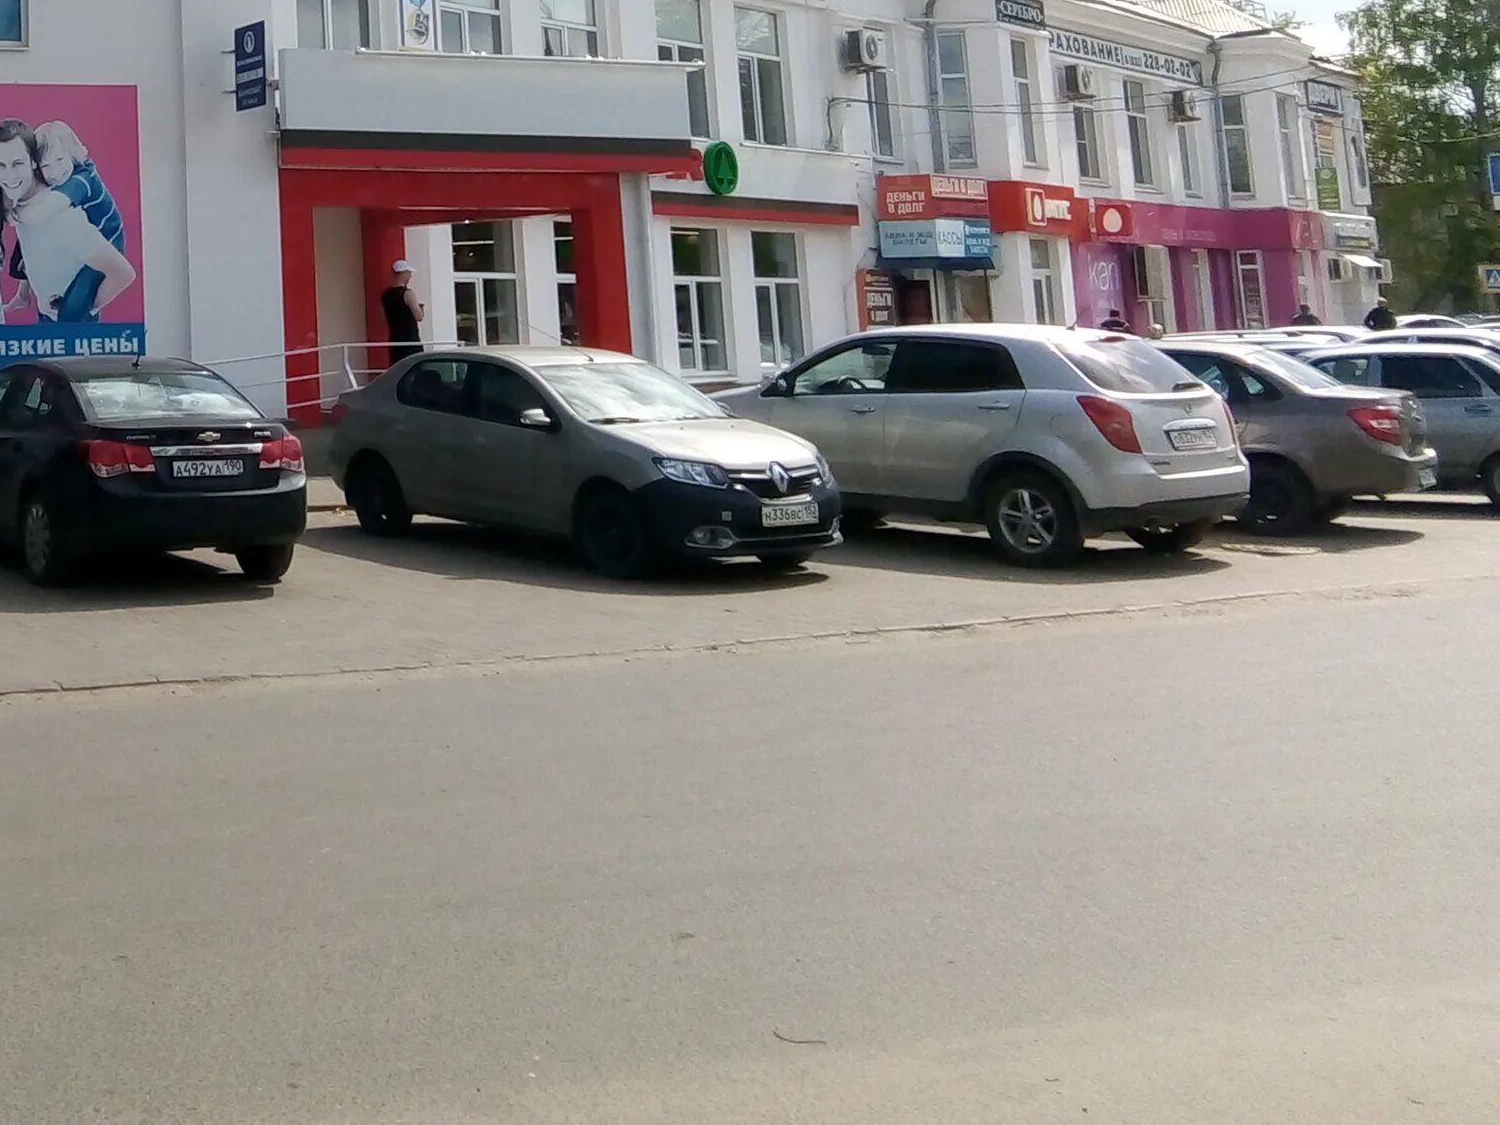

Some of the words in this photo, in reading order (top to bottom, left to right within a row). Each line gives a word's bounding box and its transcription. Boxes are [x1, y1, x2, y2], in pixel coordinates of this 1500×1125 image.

[1000, 0, 1042, 23] СЕРЕБРО
[886, 190, 926, 204] ДЕНЬГИ
[887, 203, 895, 214] В
[897, 202, 926, 215] ДОЛГ
[75, 337, 140, 356] ЦЕНЫ
